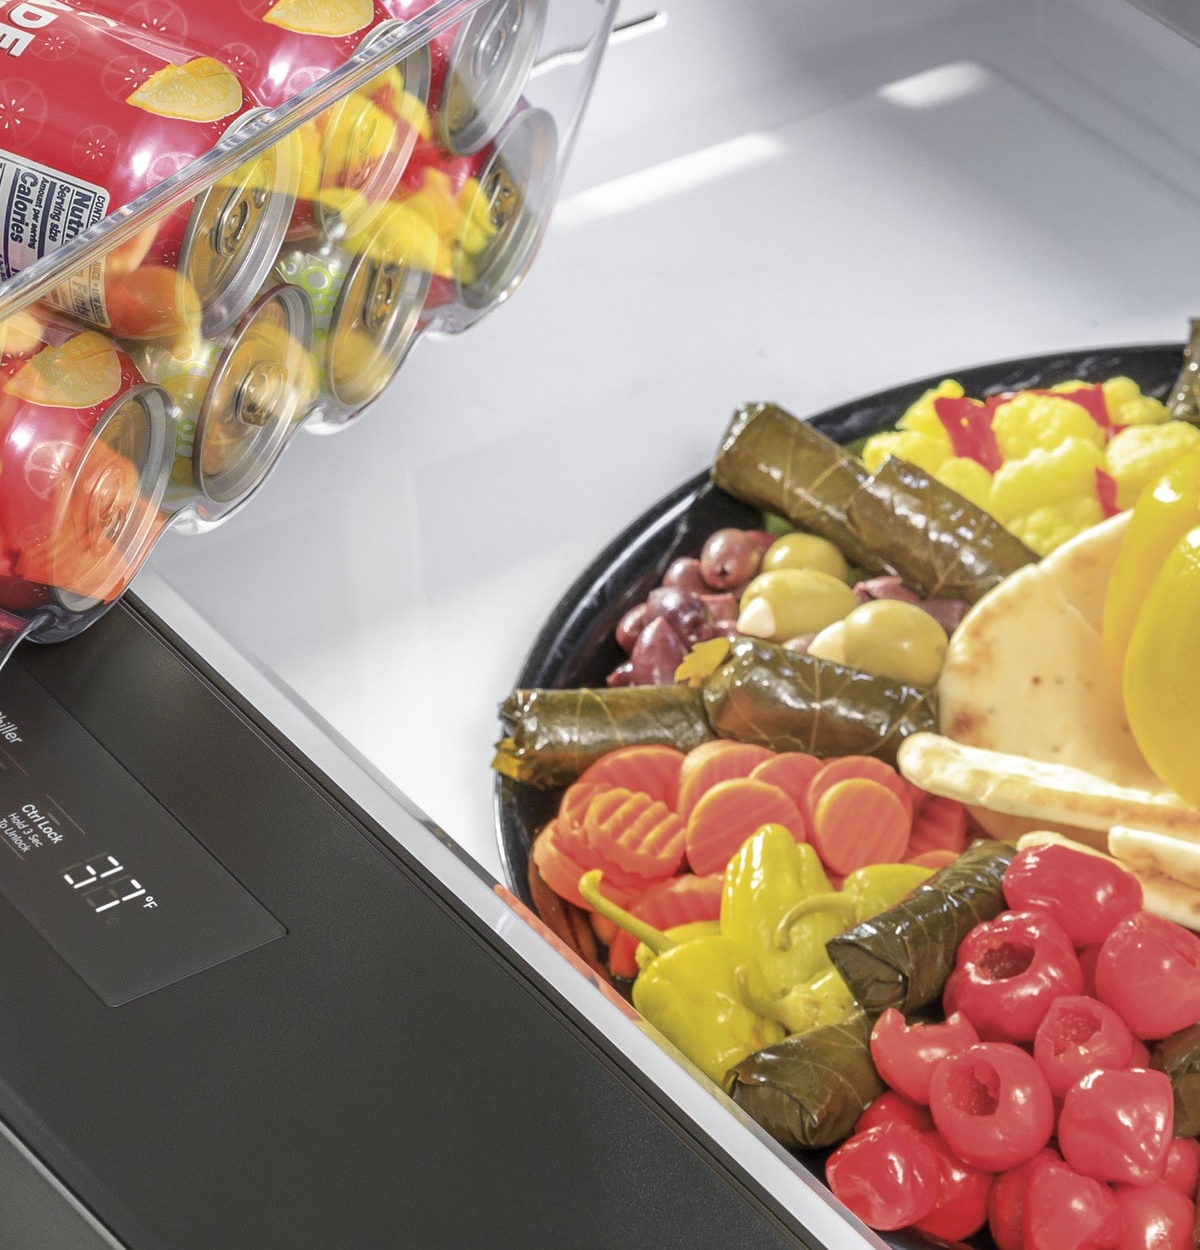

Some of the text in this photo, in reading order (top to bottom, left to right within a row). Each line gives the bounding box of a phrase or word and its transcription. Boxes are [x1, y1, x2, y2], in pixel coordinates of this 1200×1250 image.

[10, 171, 39, 244] Calories
[28, 176, 50, 250] Amount per serving
[48, 184, 71, 242] Serving size
[4, 827, 32, 854] Unlock
[7, 812, 29, 830] Hold
[28, 833, 44, 848] Sec
[21, 803, 64, 844] Ctrl Lock
[63, 854, 147, 913] 37
